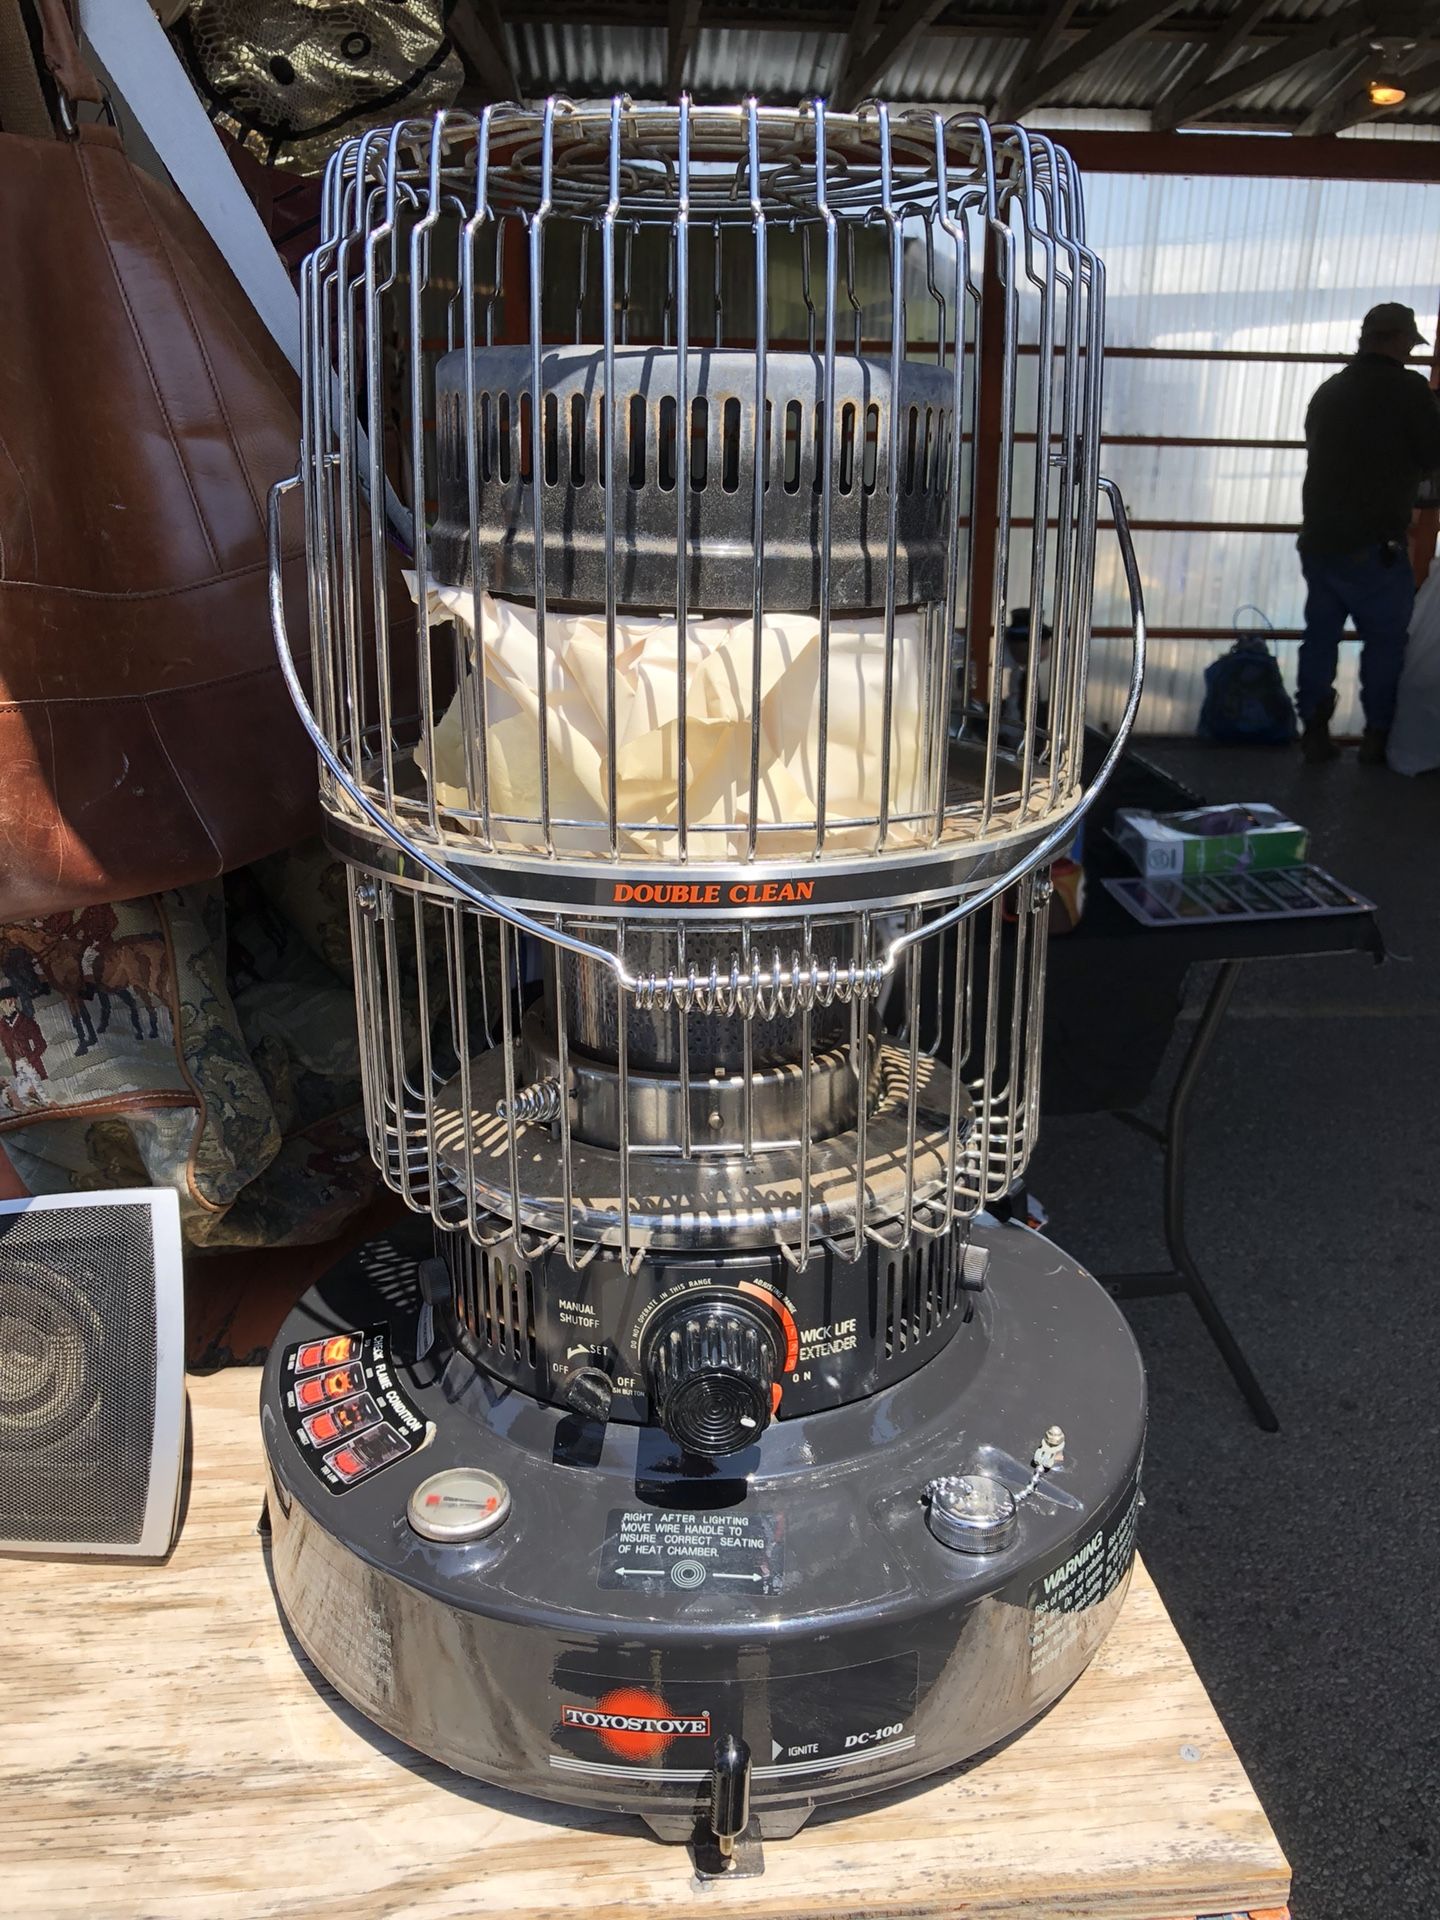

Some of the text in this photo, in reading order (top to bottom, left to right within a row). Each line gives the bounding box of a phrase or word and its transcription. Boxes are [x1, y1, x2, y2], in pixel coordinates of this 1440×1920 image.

[613, 881, 815, 903] DOUBLE CLEAN
[559, 1299, 596, 1316] MANUAL
[632, 1325, 640, 1338] NOT
[637, 1299, 658, 1323] OPERATE
[669, 1283, 686, 1294] THIS
[688, 1278, 712, 1288] RANGE
[560, 1312, 600, 1329] SHUTOFF
[800, 1318, 857, 1344] WICK LIFE
[372, 1335, 384, 1361] CHECK
[589, 1344, 608, 1356] SET
[799, 1335, 857, 1361] EXTENDER
[375, 1363, 393, 1390] FLAME
[552, 1363, 569, 1374] OFF
[617, 1376, 635, 1387] OFF
[385, 1390, 423, 1432] CONDITION
[621, 1523, 742, 1536] MOVE WIRE HANDLE TO
[623, 1513, 749, 1526] RIGHT AFTER LIGHTING
[618, 1545, 719, 1557] OF HEAT CHAMBER.
[620, 1533, 765, 1548] INSURE CORRECT SEATING
[1043, 1530, 1103, 1594] WARNING
[567, 1709, 706, 1734] TOYOSTOVE
[787, 1722, 903, 1756] IGNITE DC-100
